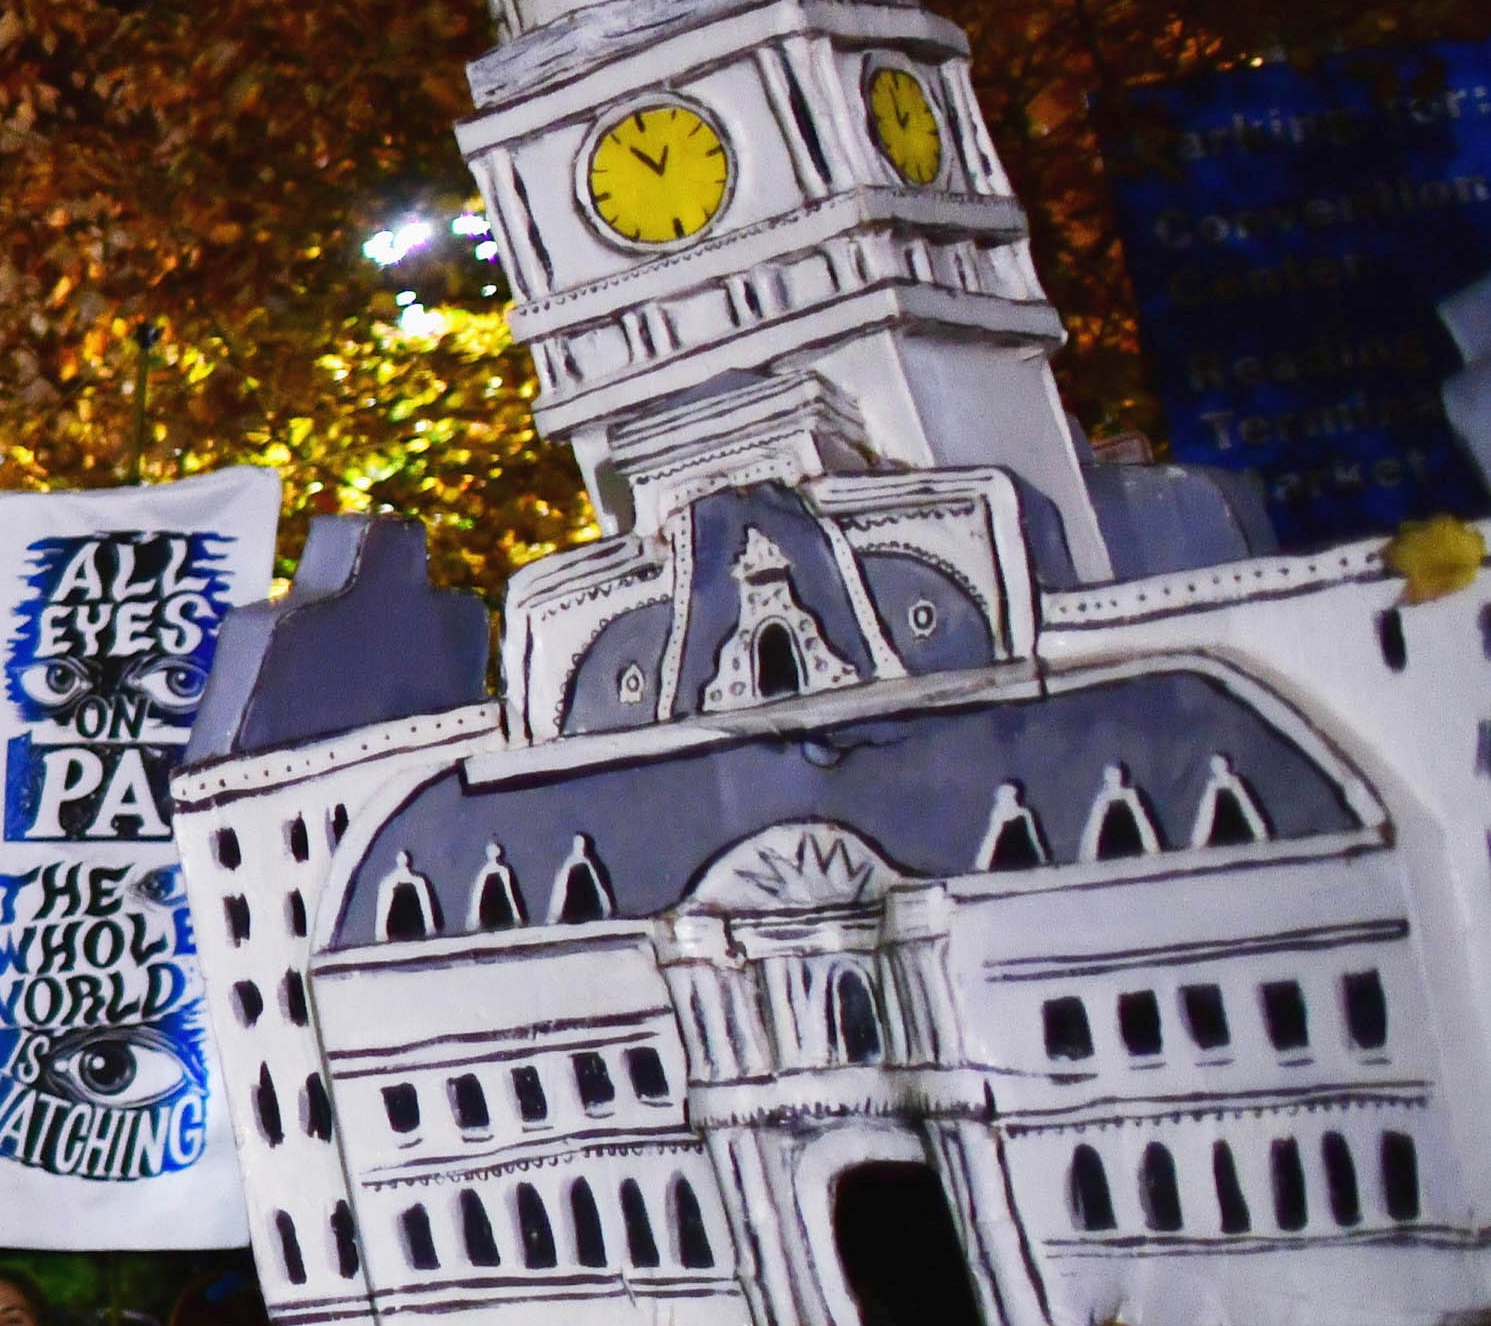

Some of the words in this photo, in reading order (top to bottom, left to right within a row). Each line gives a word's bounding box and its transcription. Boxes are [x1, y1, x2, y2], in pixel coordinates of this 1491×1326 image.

[1168, 107, 1354, 161] arking
[1198, 381, 1442, 451] Termina
[1270, 447, 1428, 504] arket
[50, 536, 210, 603] ALL
[33, 592, 220, 658] EYES
[75, 692, 152, 740] ON
[24, 746, 173, 839] PA
[0, 1031, 51, 1084] IS
